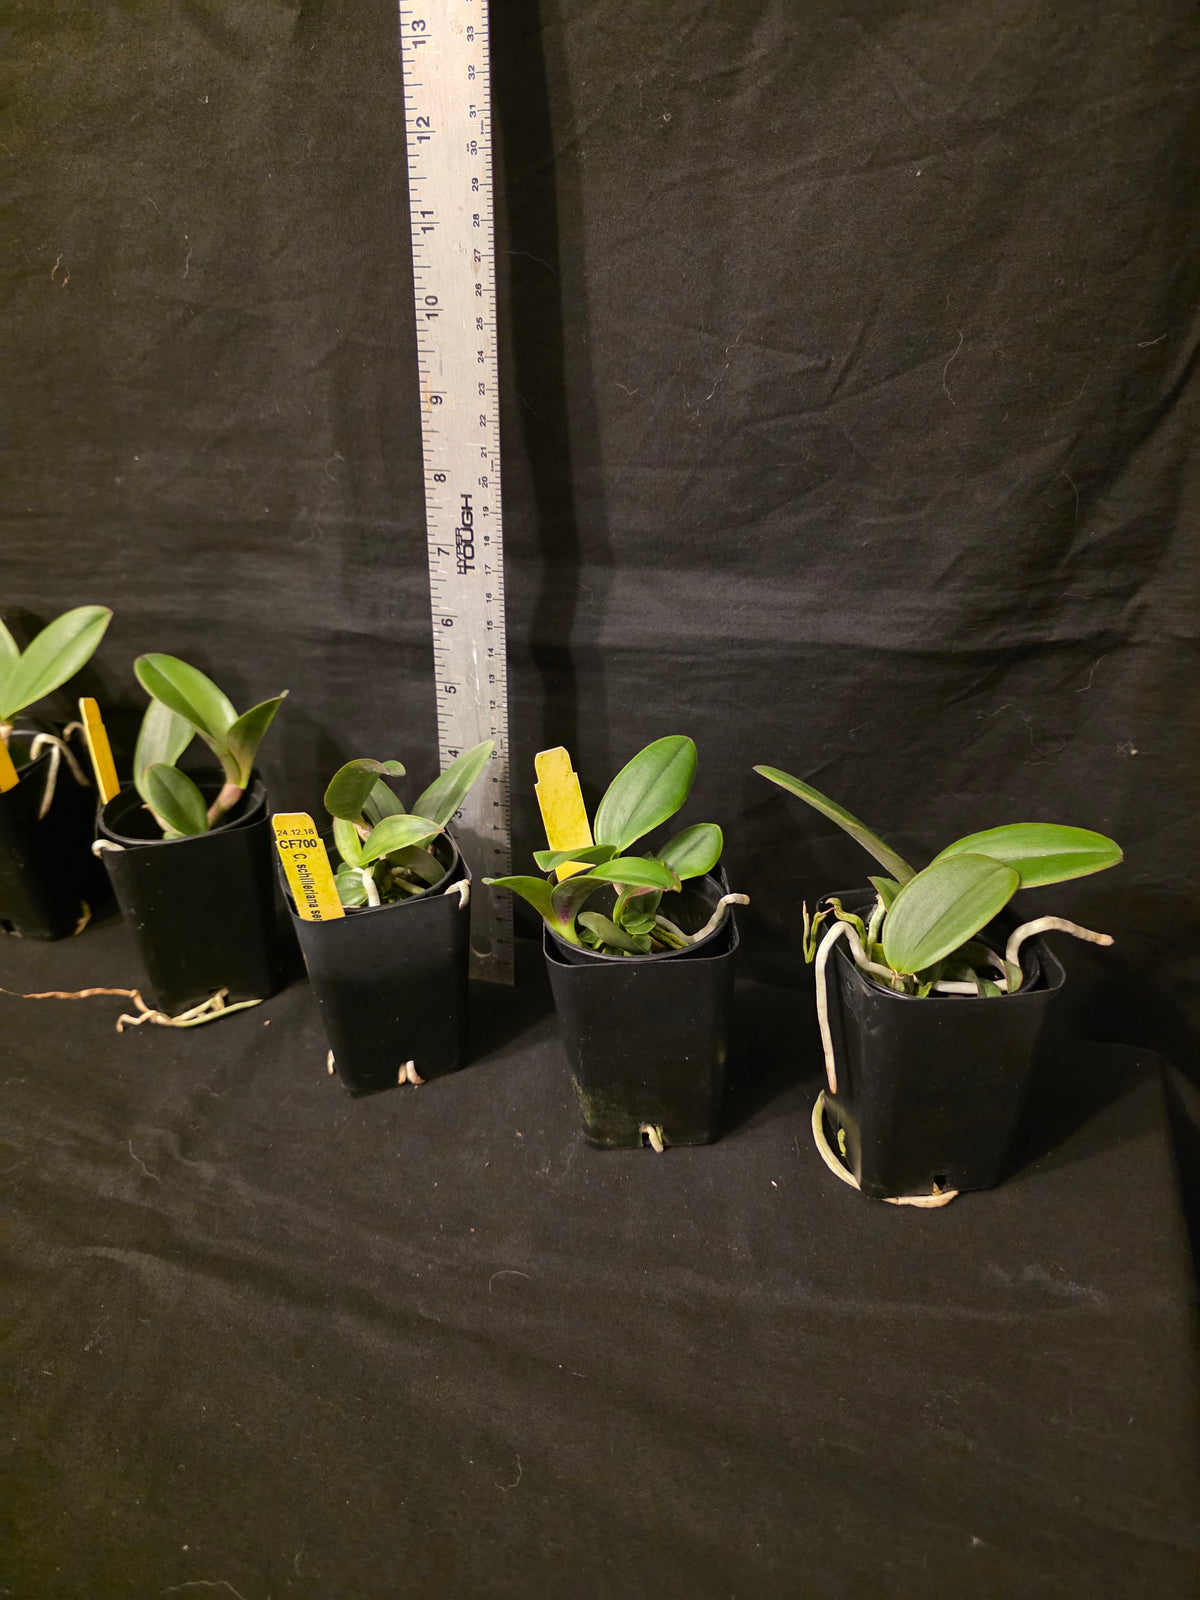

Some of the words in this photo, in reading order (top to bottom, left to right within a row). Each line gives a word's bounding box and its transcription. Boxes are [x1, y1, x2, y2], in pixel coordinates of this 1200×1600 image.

[411, 19, 427, 49] 13
[466, 25, 475, 42] 33
[467, 64, 476, 80] 32
[469, 104, 477, 118] 31
[415, 115, 431, 144] 12
[470, 140, 478, 155] 30
[471, 177, 479, 192] 29
[420, 211, 435, 234] 11
[472, 213, 480, 227] 28
[473, 248, 481, 262] 27
[475, 283, 482, 297] 26
[424, 295, 439, 320] 10
[476, 317, 483, 330] 25
[477, 350, 484, 363] 24
[478, 382, 485, 396] 23
[430, 395, 443, 405] 9
[479, 414, 487, 427] 22
[480, 446, 488, 458] 21
[433, 473, 446, 483] 8
[481, 476, 489, 488] 20
[482, 506, 489, 517] 19
[460, 494, 475, 575] TOUGH
[484, 535, 490, 547] 18
[437, 547, 450, 556] 7
[455, 527, 465, 575] HYPER
[485, 564, 492, 575] 17
[486, 592, 492, 603] 16
[441, 618, 454, 627] 6
[486, 620, 493, 631] 15
[488, 647, 494, 657] 14
[489, 674, 495, 684] 13
[445, 685, 457, 694] 5
[490, 700, 496, 709] 12
[490, 727, 497, 735] 11
[448, 749, 460, 758] 4
[491, 750, 498, 760] 10
[279, 838, 318, 849] CF700
[293, 853, 307, 862] C.
[296, 864, 319, 908] schilleriana
